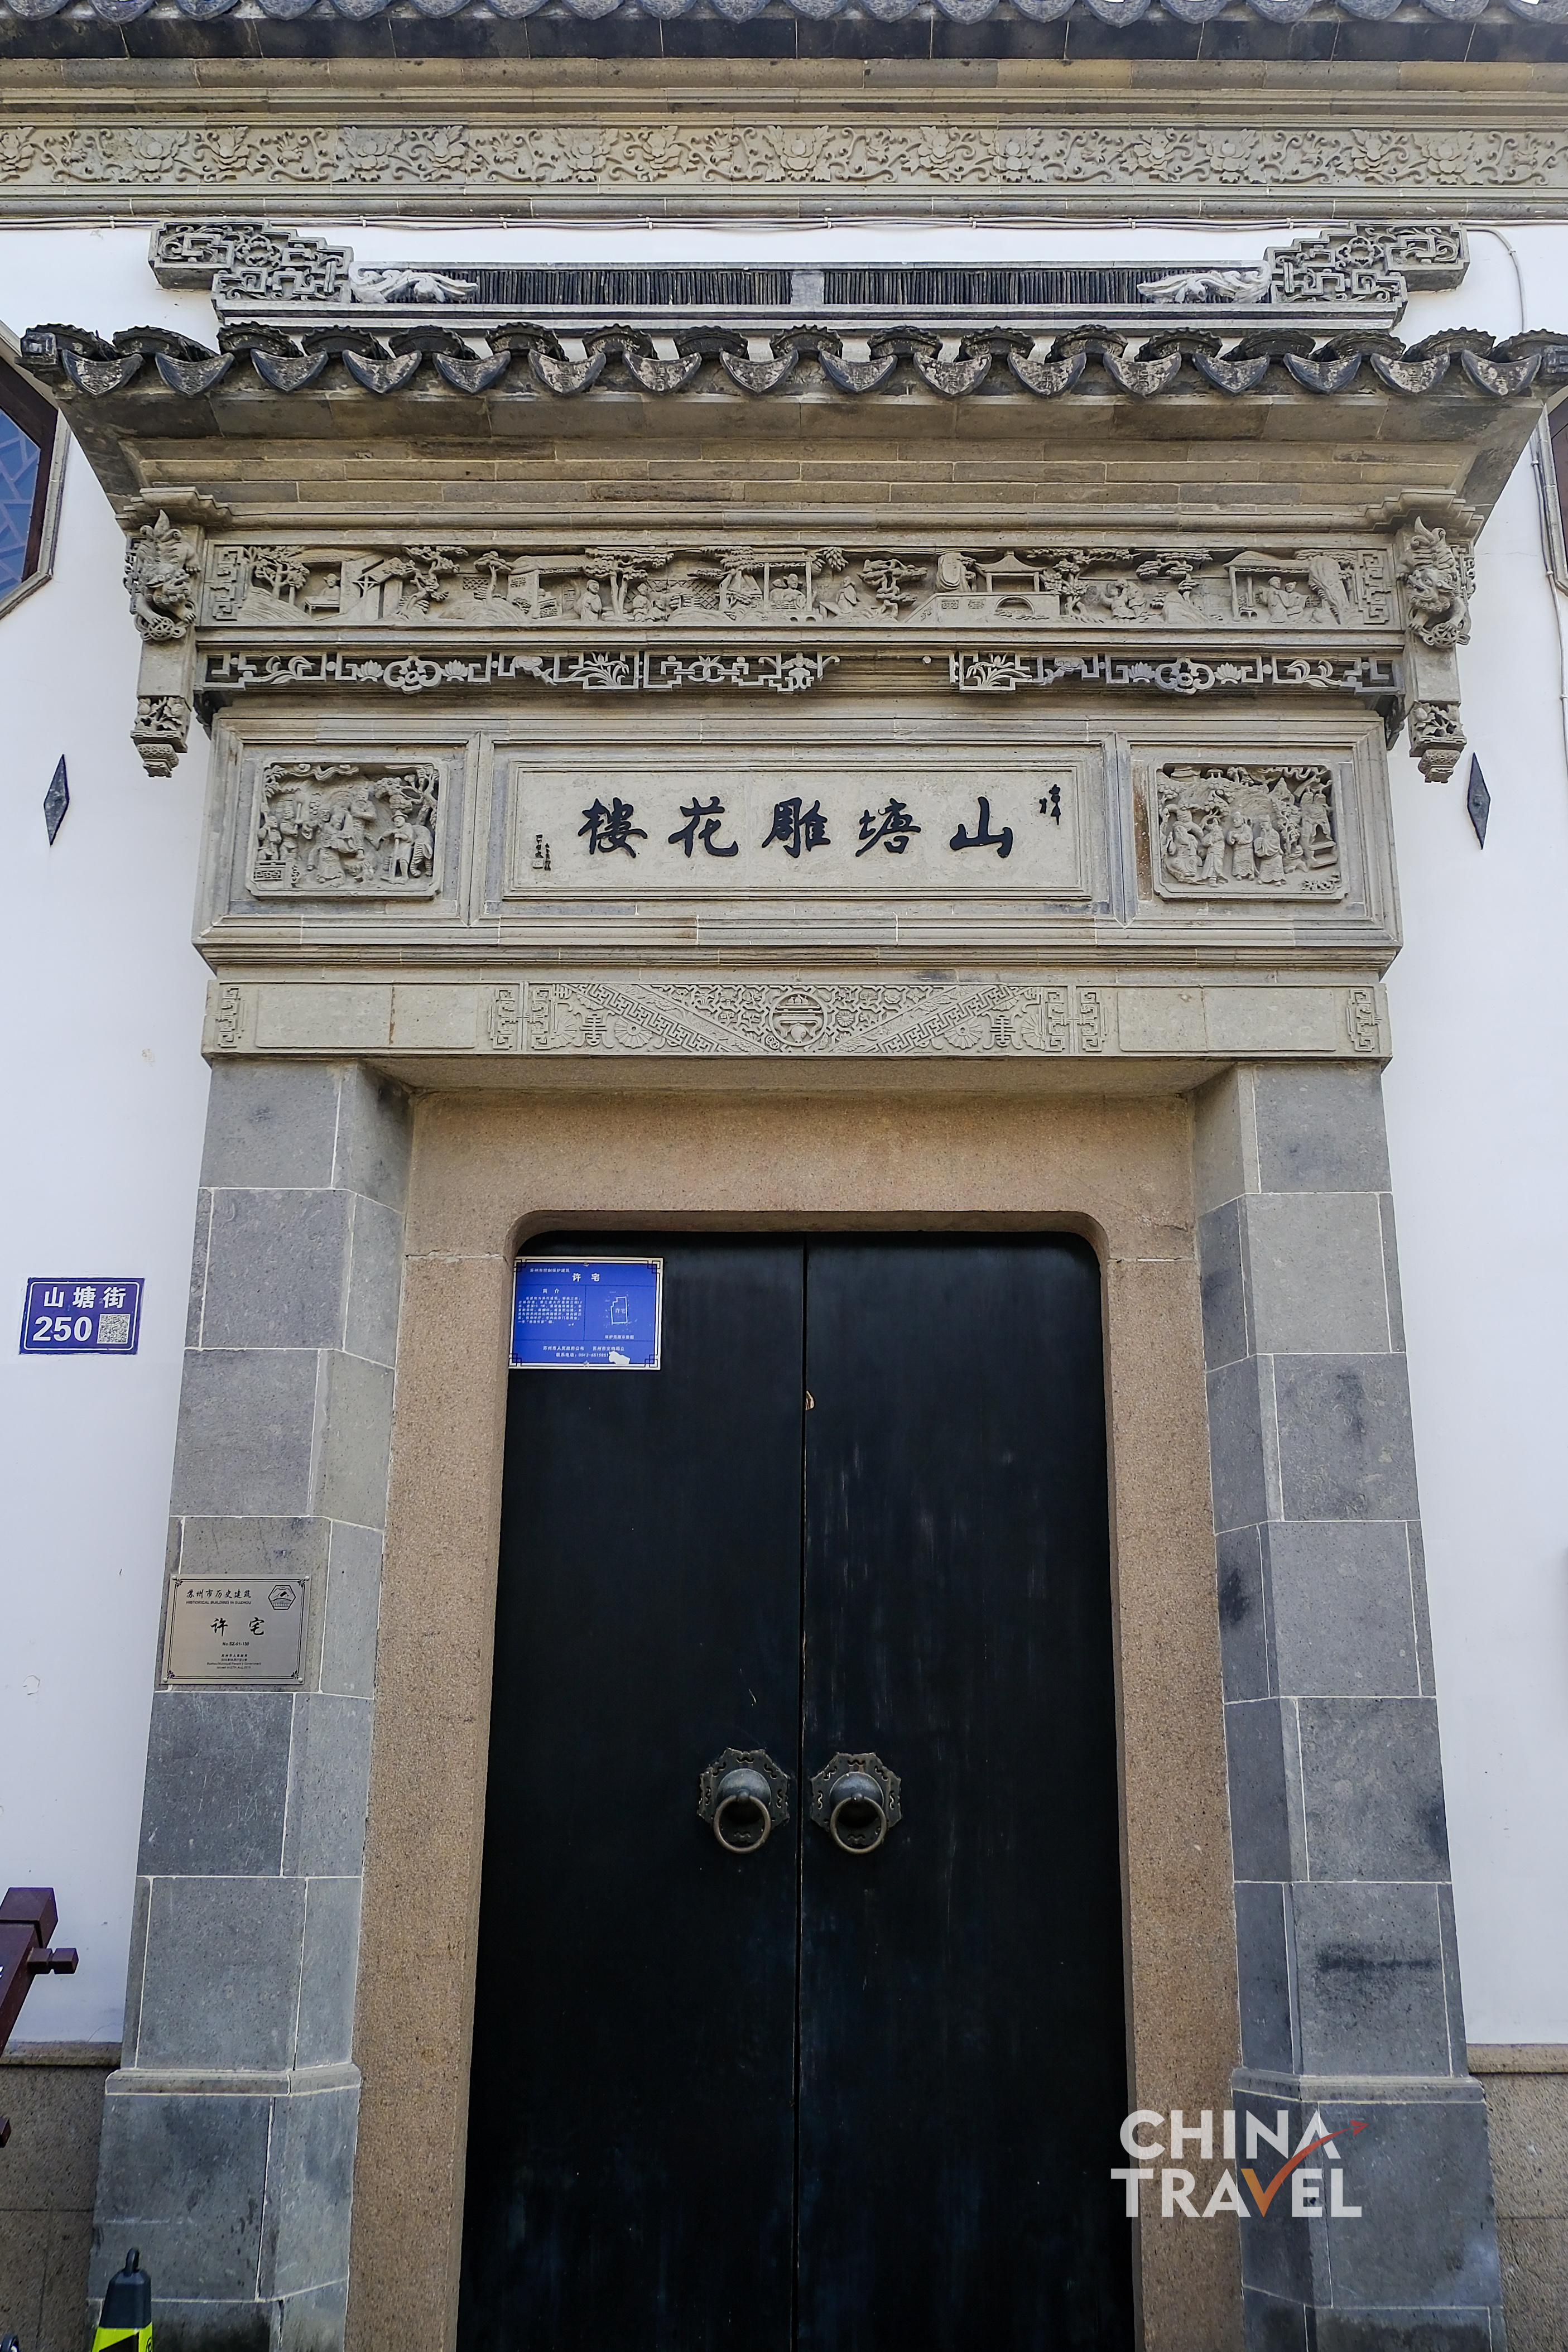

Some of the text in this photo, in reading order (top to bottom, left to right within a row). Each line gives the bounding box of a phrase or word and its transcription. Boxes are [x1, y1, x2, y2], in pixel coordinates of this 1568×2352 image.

[572, 1272, 600, 1282] 许宅
[44, 1286, 127, 1309] 山塘街
[32, 1315, 93, 1342] 250
[186, 1589, 252, 1599] 苏州市历史建筑
[210, 1617, 265, 1637] 许宅
